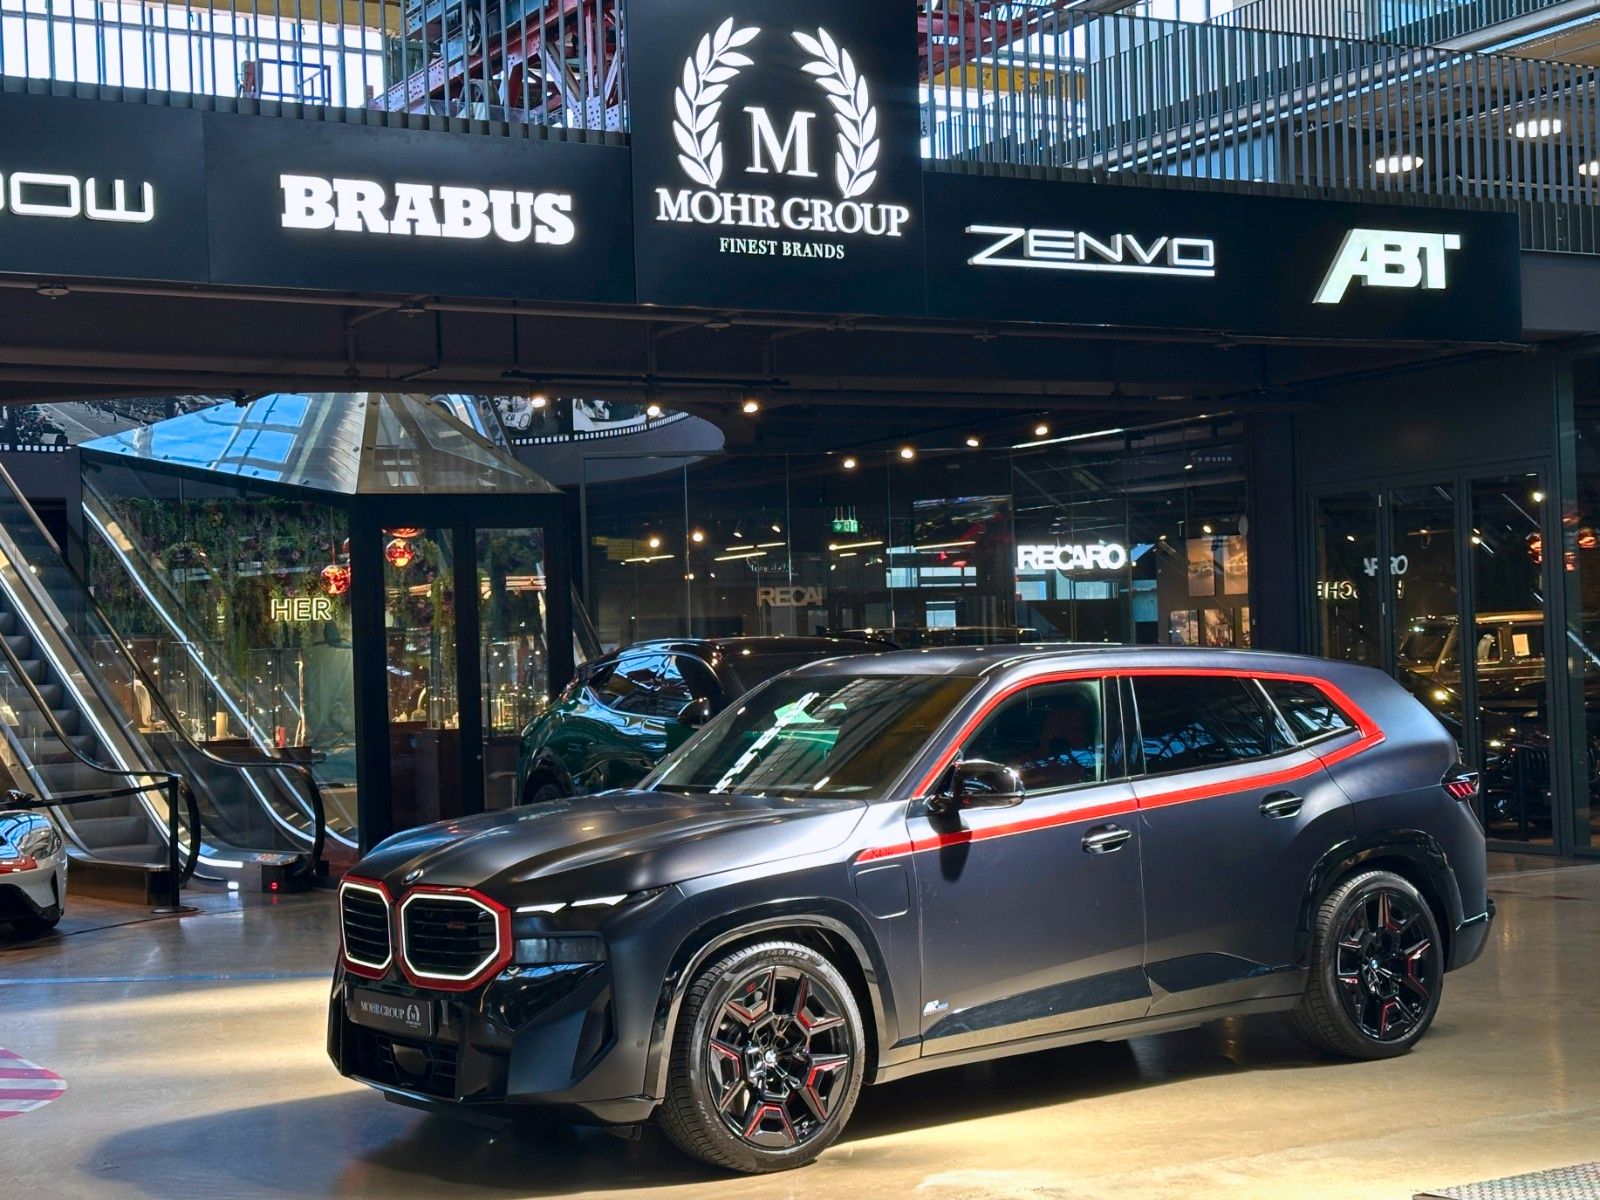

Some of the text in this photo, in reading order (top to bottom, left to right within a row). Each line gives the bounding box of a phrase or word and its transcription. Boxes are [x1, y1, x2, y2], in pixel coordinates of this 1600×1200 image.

[743, 106, 818, 177] M
[280, 174, 576, 246] BRABUS
[655, 187, 910, 236] MOHR GROUP
[719, 237, 845, 260] FINEST BRANDS
[965, 225, 1215, 277] ZENVO
[1312, 228, 1461, 304] ABT
[1017, 543, 1127, 570] RECARO
[271, 597, 332, 621] HER
[380, 1005, 405, 1019] GROUP
